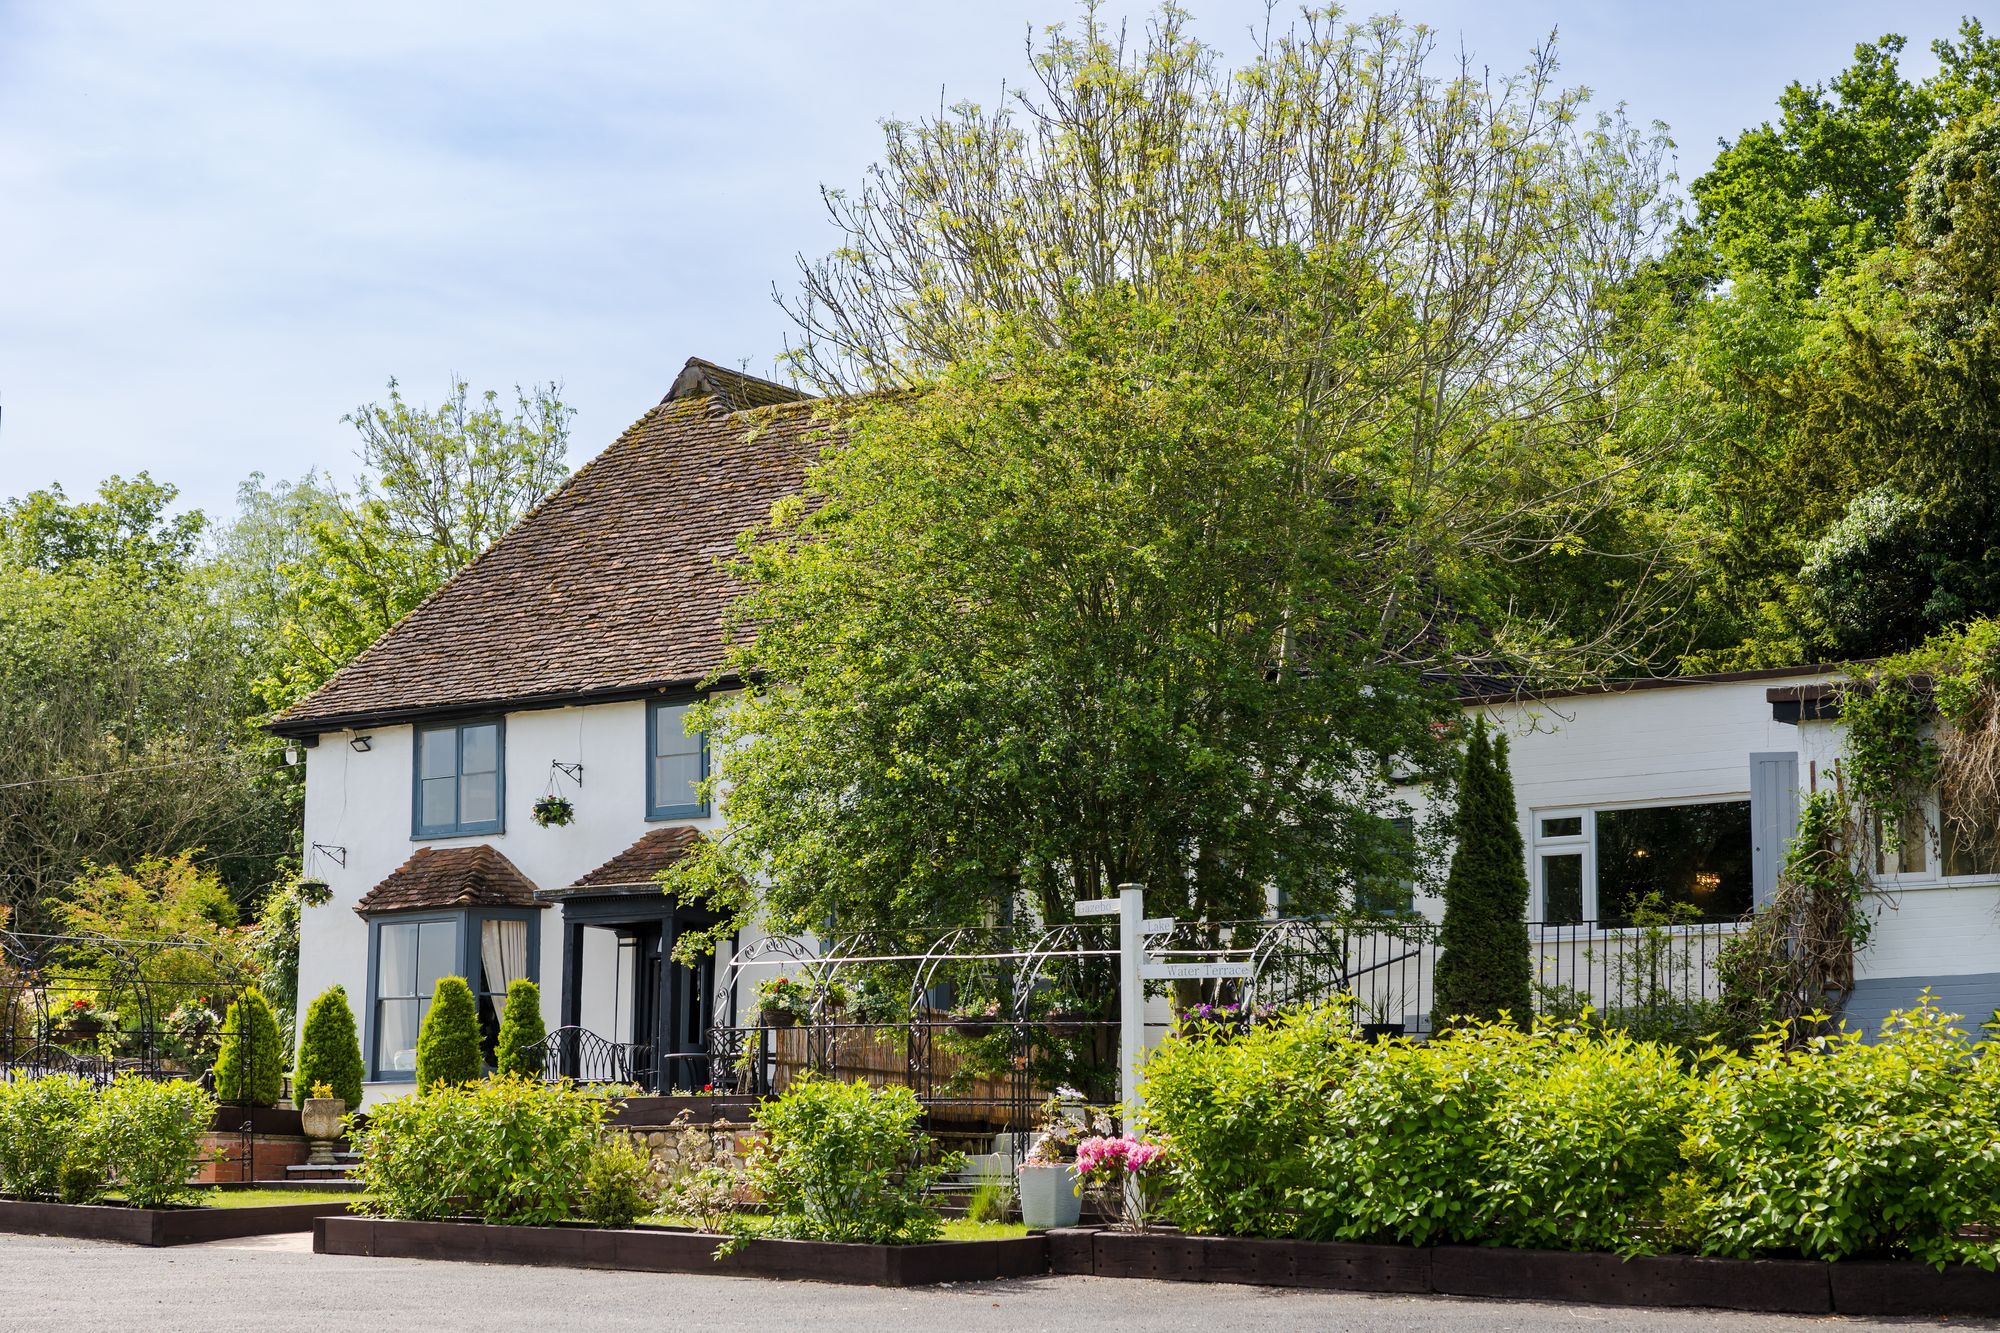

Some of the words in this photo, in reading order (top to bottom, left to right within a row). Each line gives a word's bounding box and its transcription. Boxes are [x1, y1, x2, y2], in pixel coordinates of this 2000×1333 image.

[1077, 902, 1112, 914] Gazebo
[1147, 920, 1170, 932] Lake
[1167, 965, 1200, 977] Water
[1203, 964, 1248, 976] Terrace
